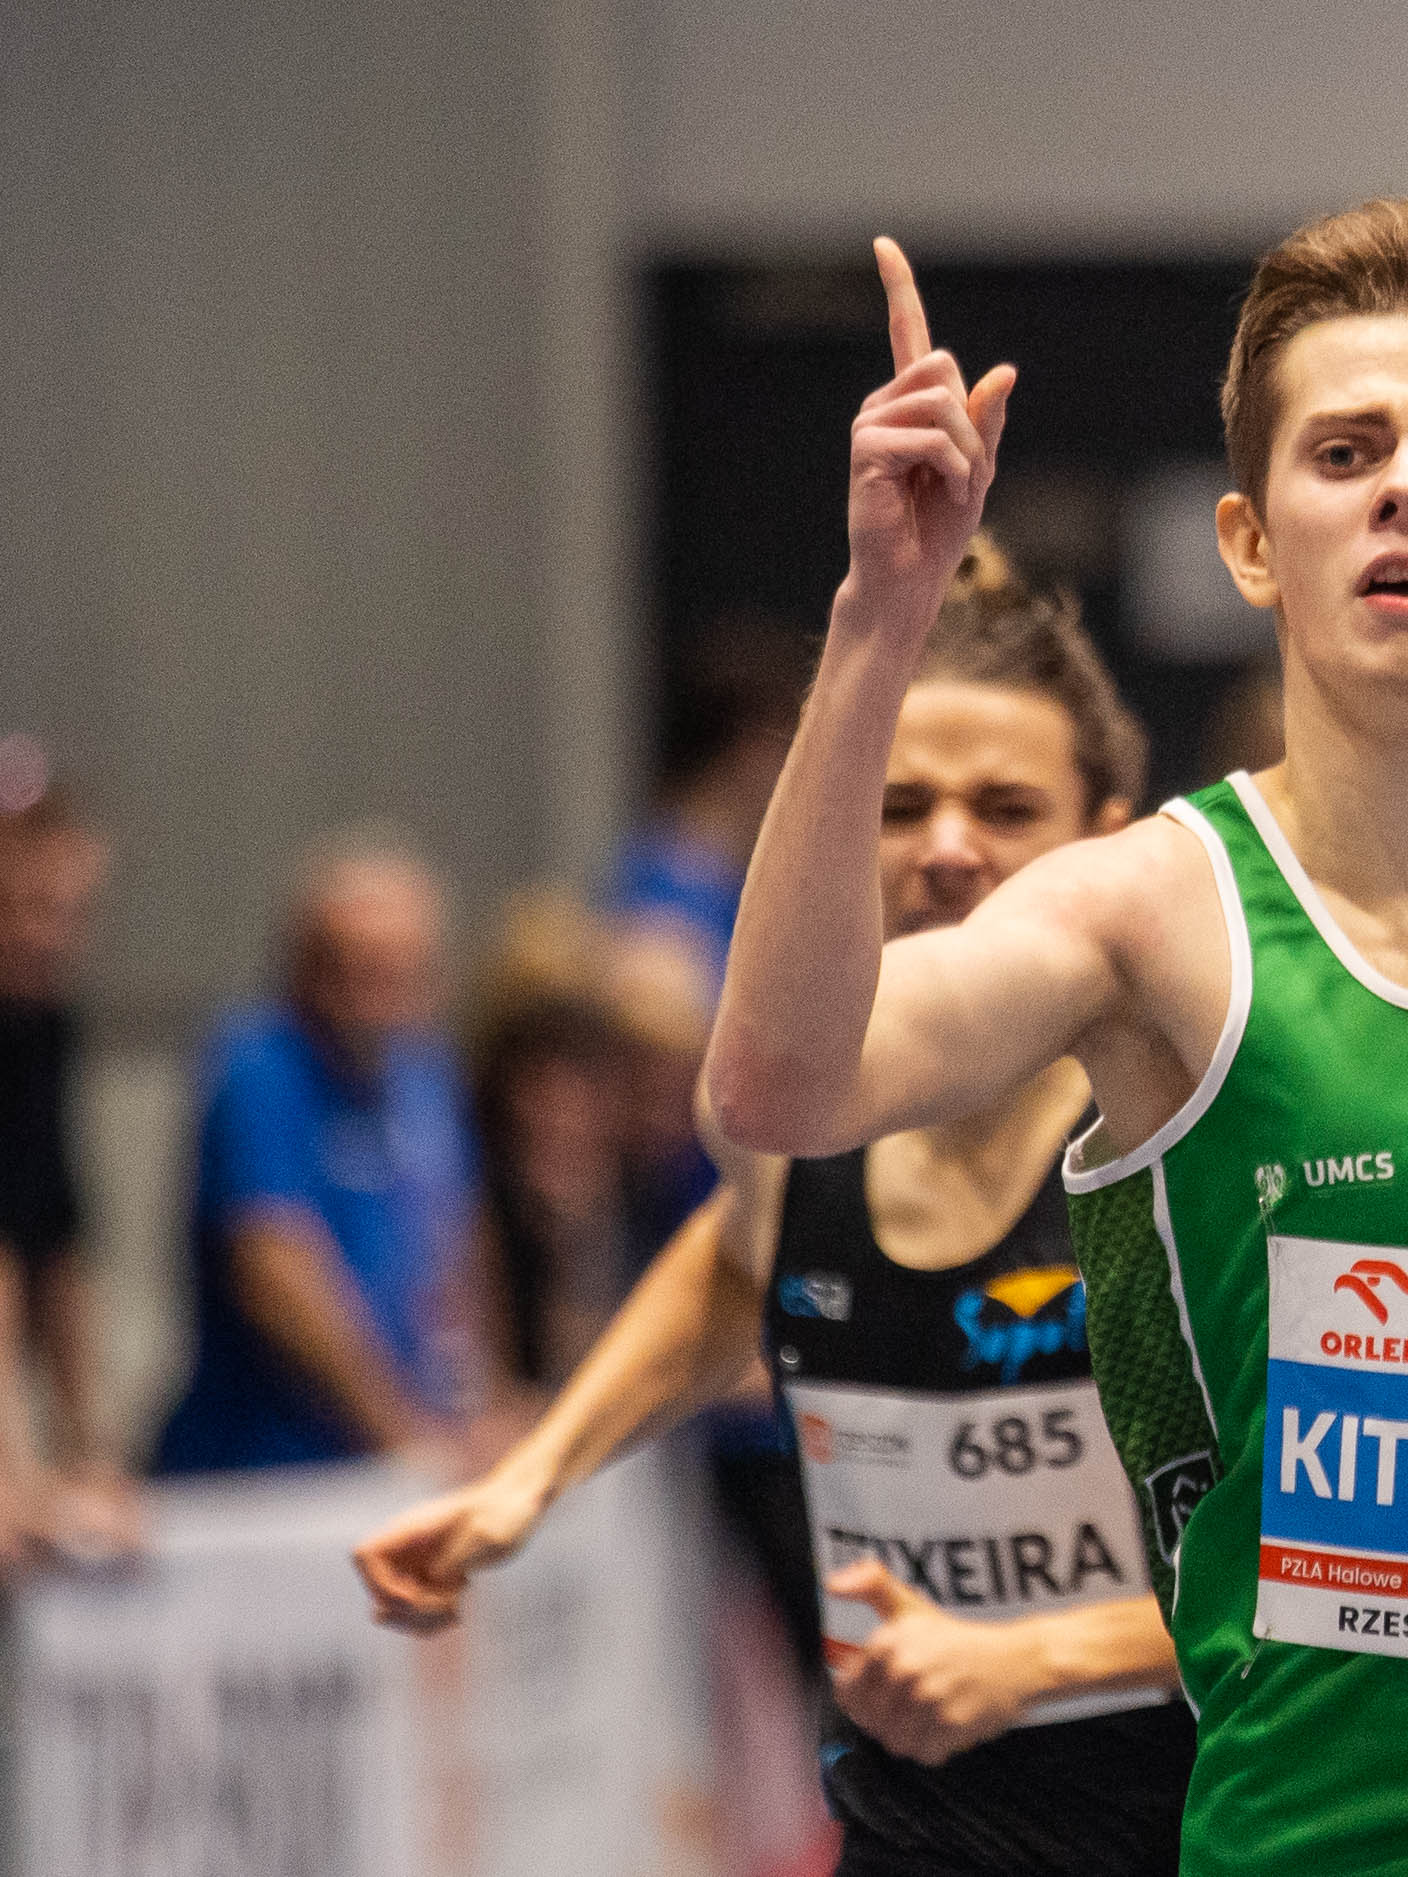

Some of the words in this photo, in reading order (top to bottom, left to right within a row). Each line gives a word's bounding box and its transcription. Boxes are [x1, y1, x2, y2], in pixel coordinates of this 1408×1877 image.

[1303, 1151, 1395, 1187] UMCS
[949, 1408, 1086, 1479] 685
[1281, 1556, 1323, 1580] PZLA
[1328, 1564, 1402, 1590] Halowe
